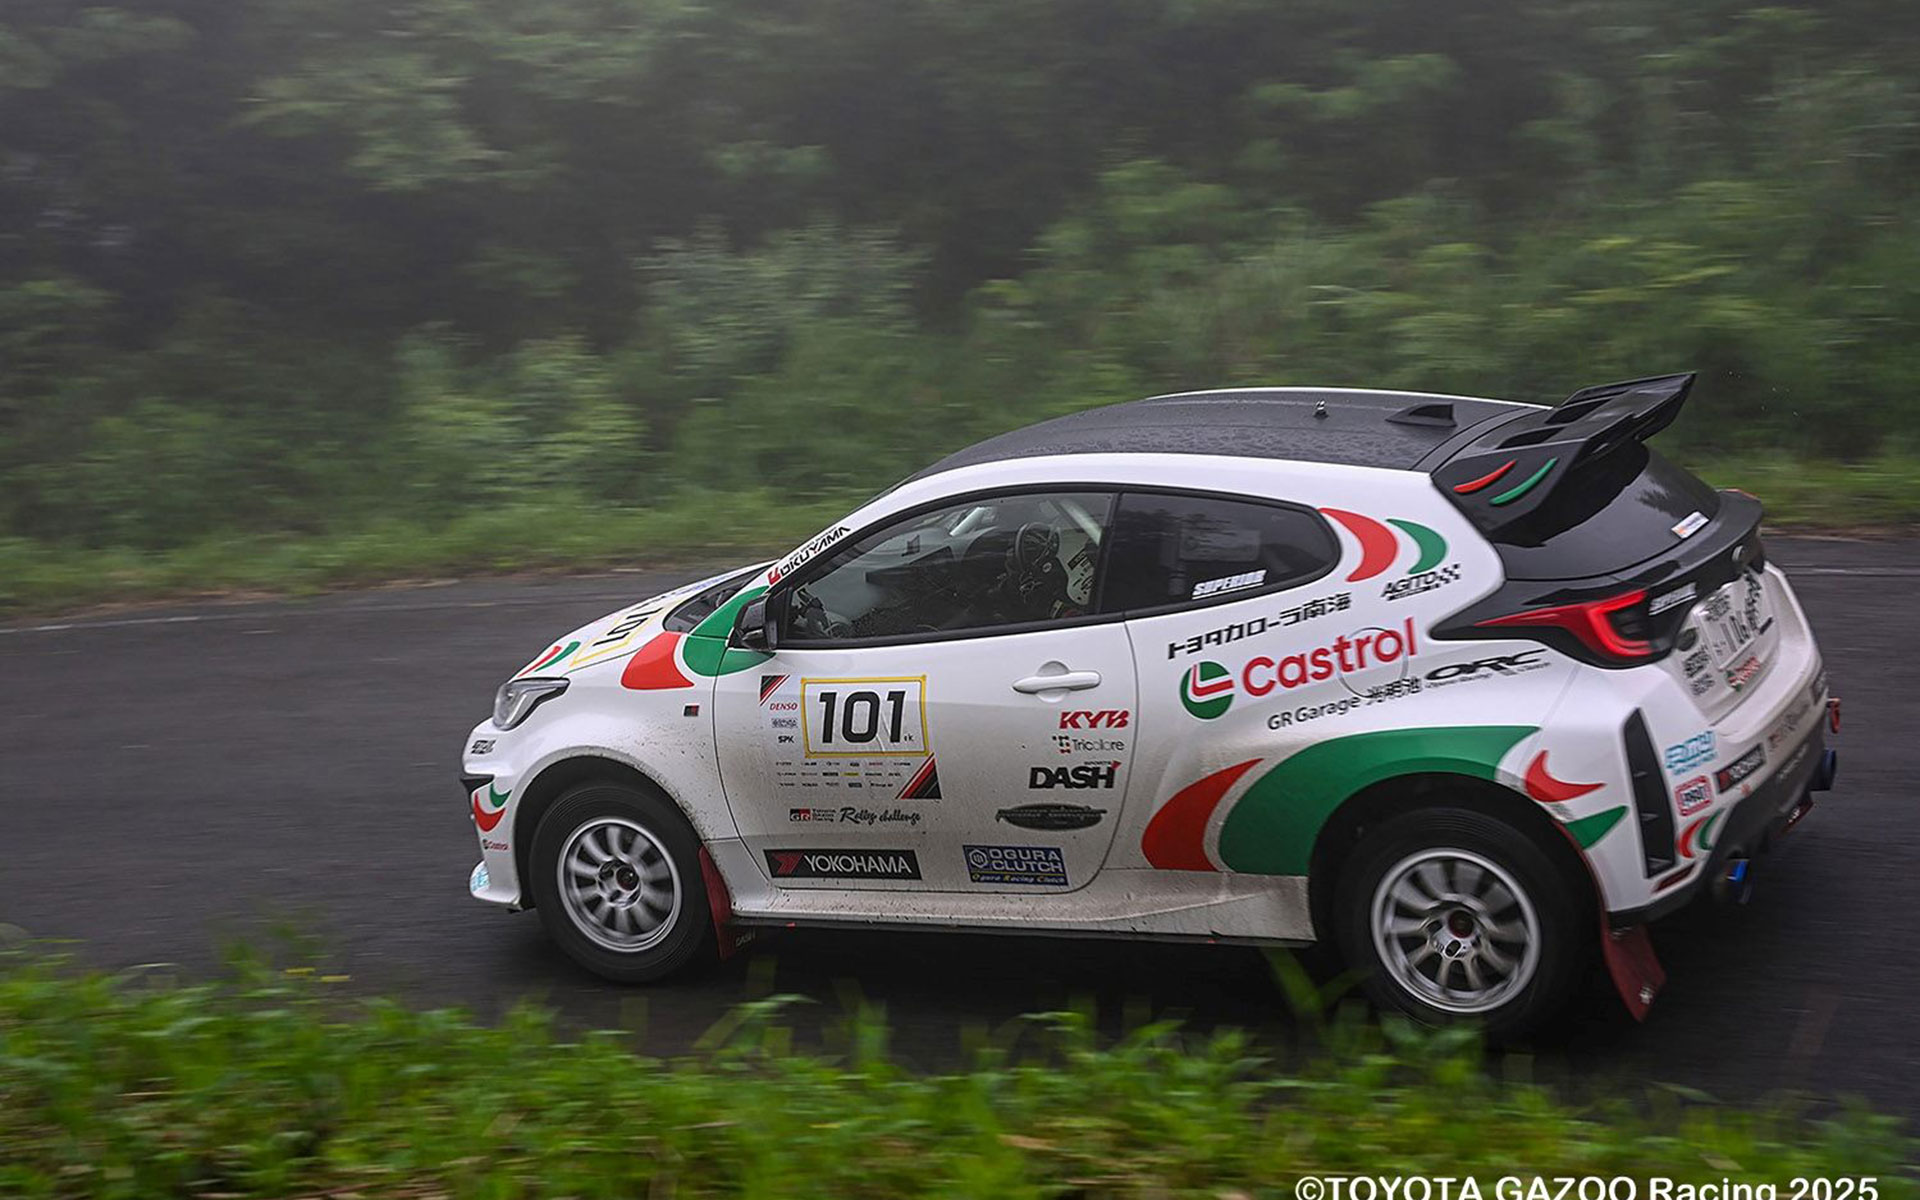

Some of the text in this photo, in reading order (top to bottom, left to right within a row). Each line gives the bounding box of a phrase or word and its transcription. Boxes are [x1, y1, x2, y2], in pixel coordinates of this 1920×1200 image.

[780, 526, 851, 576] OKUYAMA
[1168, 592, 1351, 659] トヨタカローラ南海
[1242, 617, 1418, 697] Castrol
[769, 702, 798, 711] DENSO
[1267, 711, 1293, 731] GR
[1294, 696, 1361, 723] Garage
[819, 690, 906, 743] 101
[1059, 710, 1129, 729] KYB
[778, 735, 795, 744] SPK
[1072, 739, 1125, 752] Tricolore
[1029, 765, 1115, 789] DASH
[804, 855, 912, 873] YOKOHAMA
[989, 848, 1061, 861] OGURA
[991, 860, 1064, 873] CLUTCH
